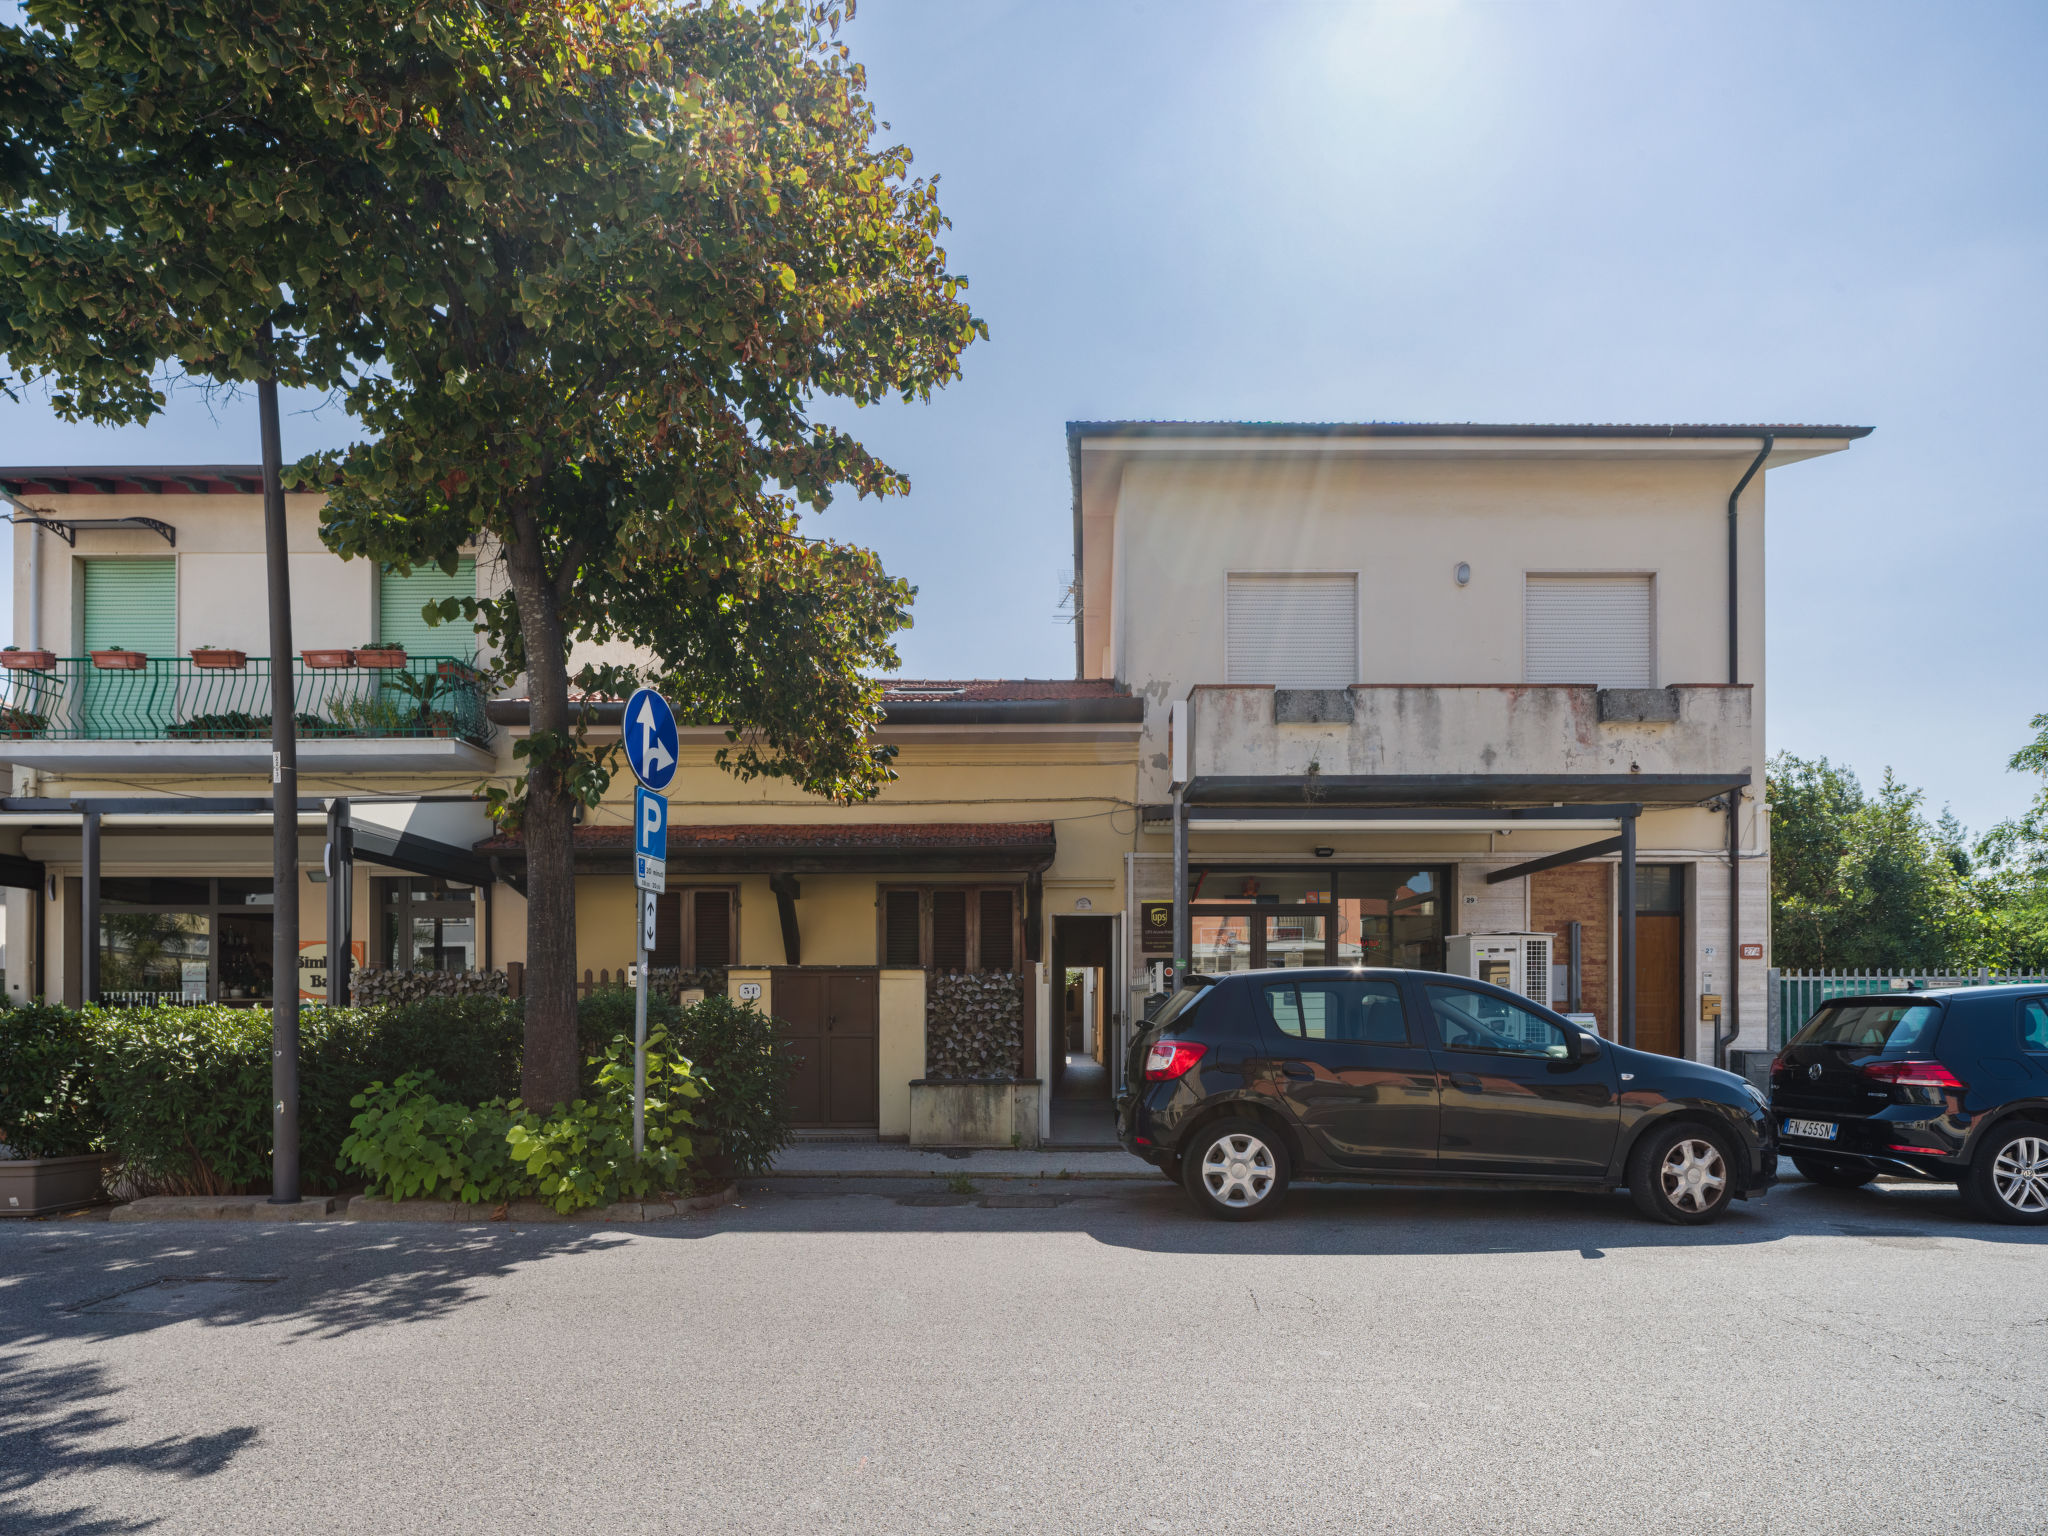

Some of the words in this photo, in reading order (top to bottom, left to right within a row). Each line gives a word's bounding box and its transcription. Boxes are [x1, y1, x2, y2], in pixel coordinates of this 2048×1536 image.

[642, 795, 662, 849] P
[1152, 913, 1167, 924] ups
[1705, 947, 1714, 955] 27
[1789, 1120, 1800, 1135] FN
[1802, 1122, 1832, 1138] 455SN
